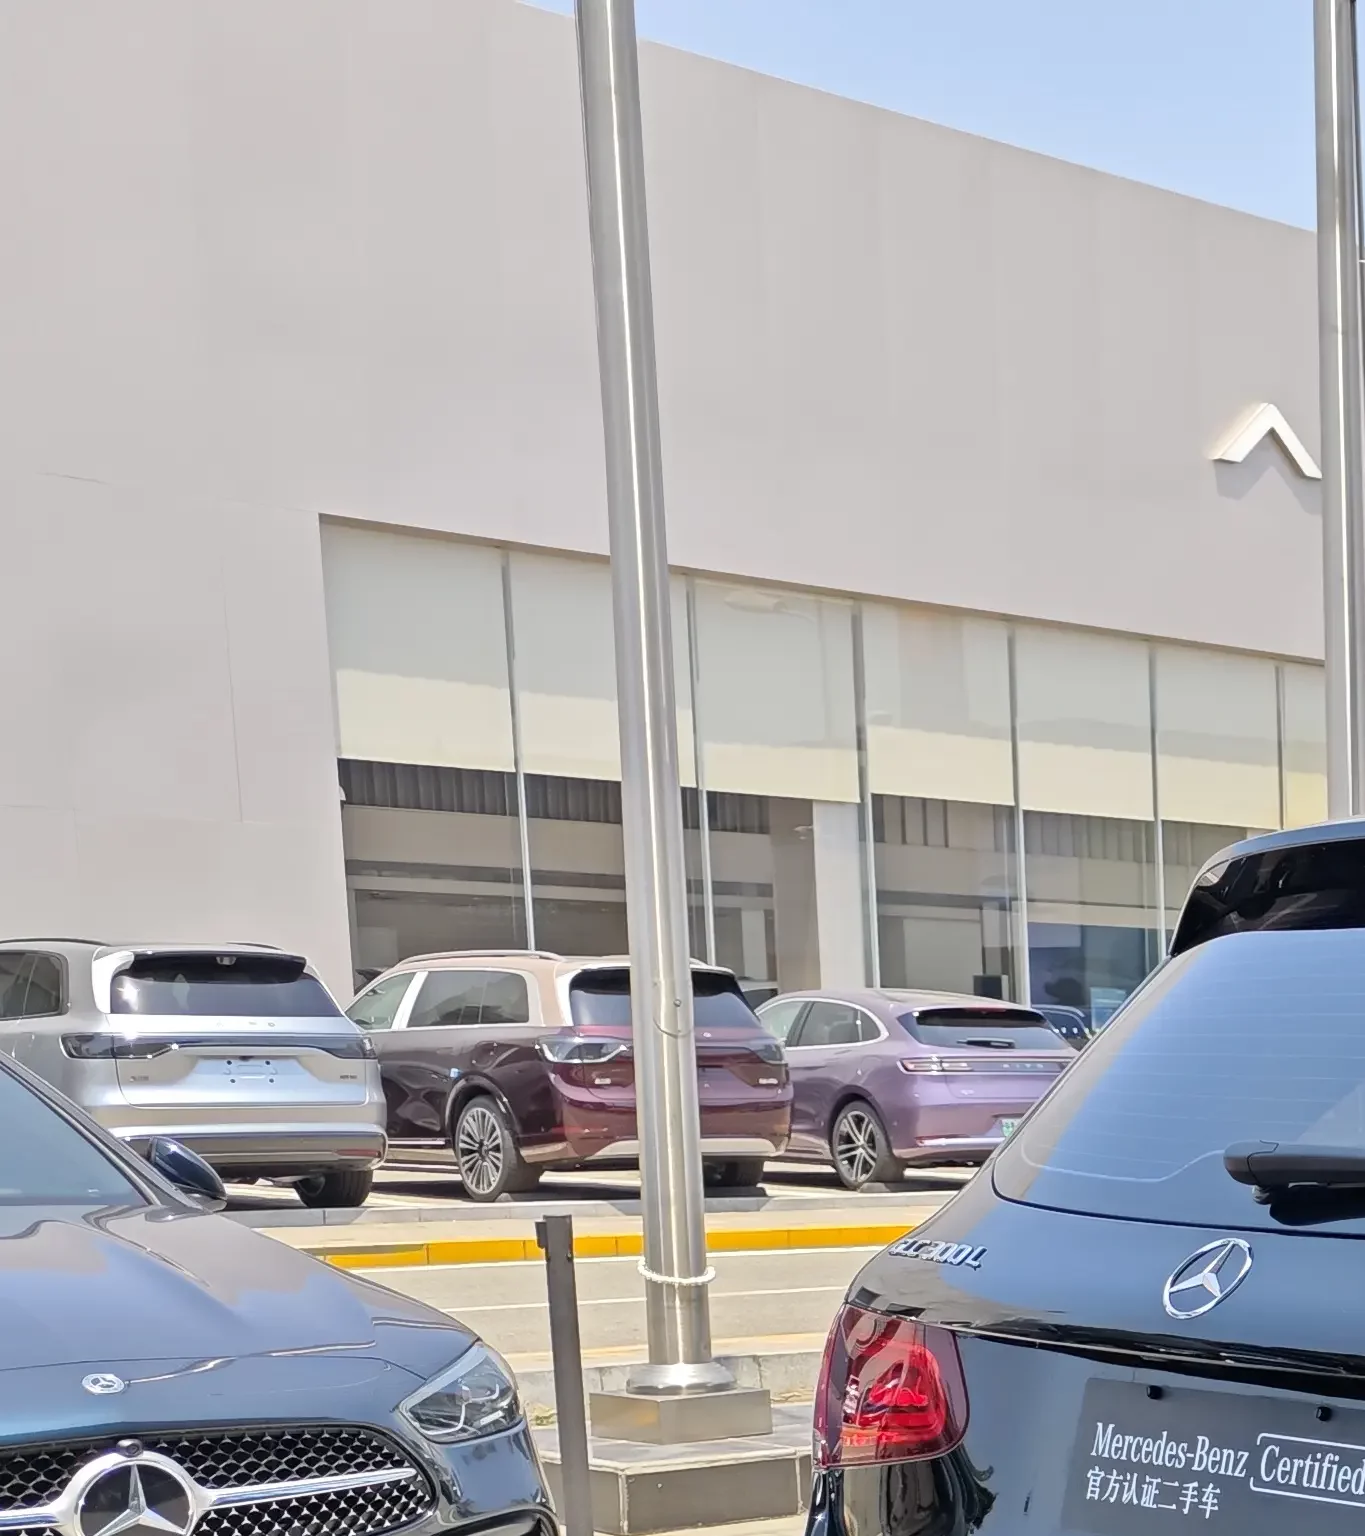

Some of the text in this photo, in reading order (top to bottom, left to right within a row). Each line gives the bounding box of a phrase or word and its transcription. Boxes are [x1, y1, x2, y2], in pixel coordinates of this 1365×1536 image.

[1090, 1422, 1250, 1478] Mercedes-Benz
[1085, 1466, 1221, 1519] 官方认证二手车
